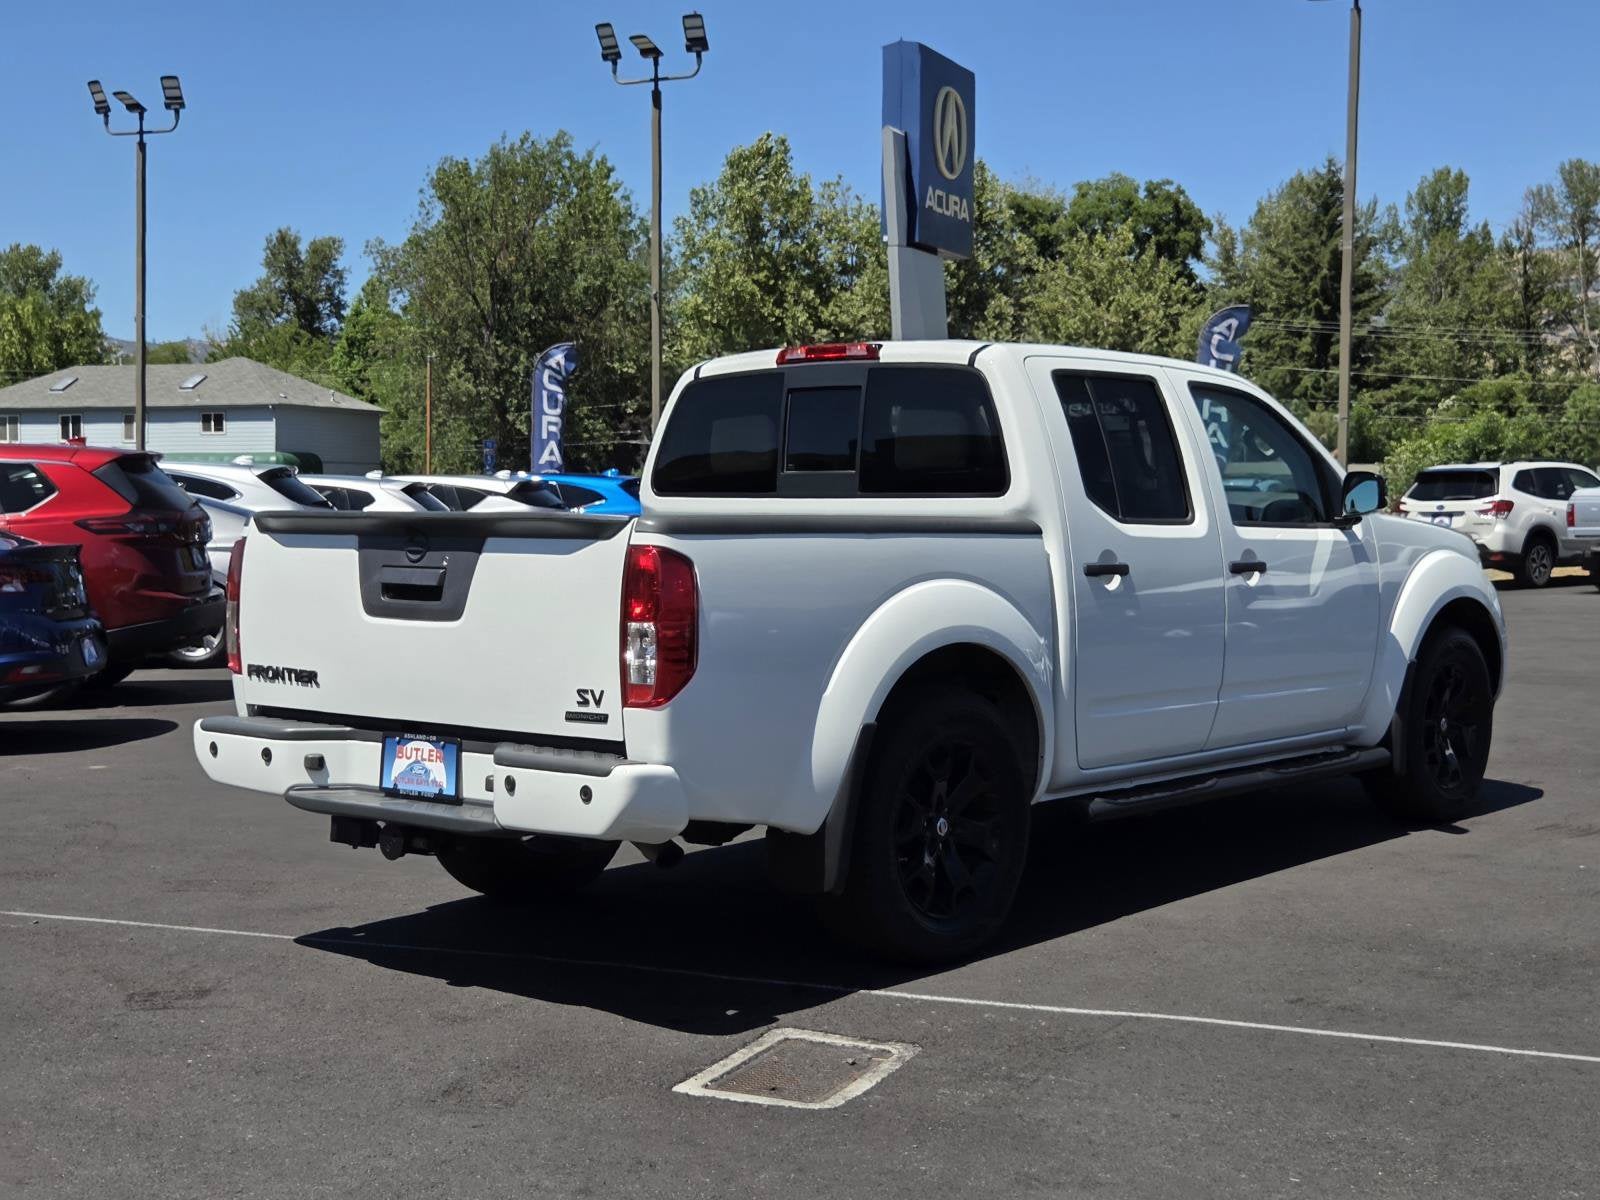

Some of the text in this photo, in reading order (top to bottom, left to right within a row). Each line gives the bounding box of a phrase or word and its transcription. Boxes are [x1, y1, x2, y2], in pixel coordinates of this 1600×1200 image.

[925, 185, 969, 223] ACURA
[538, 352, 567, 465] ACURA
[247, 664, 320, 687] FRONTIER
[576, 688, 604, 707] SV
[396, 745, 444, 763] BUTLER
